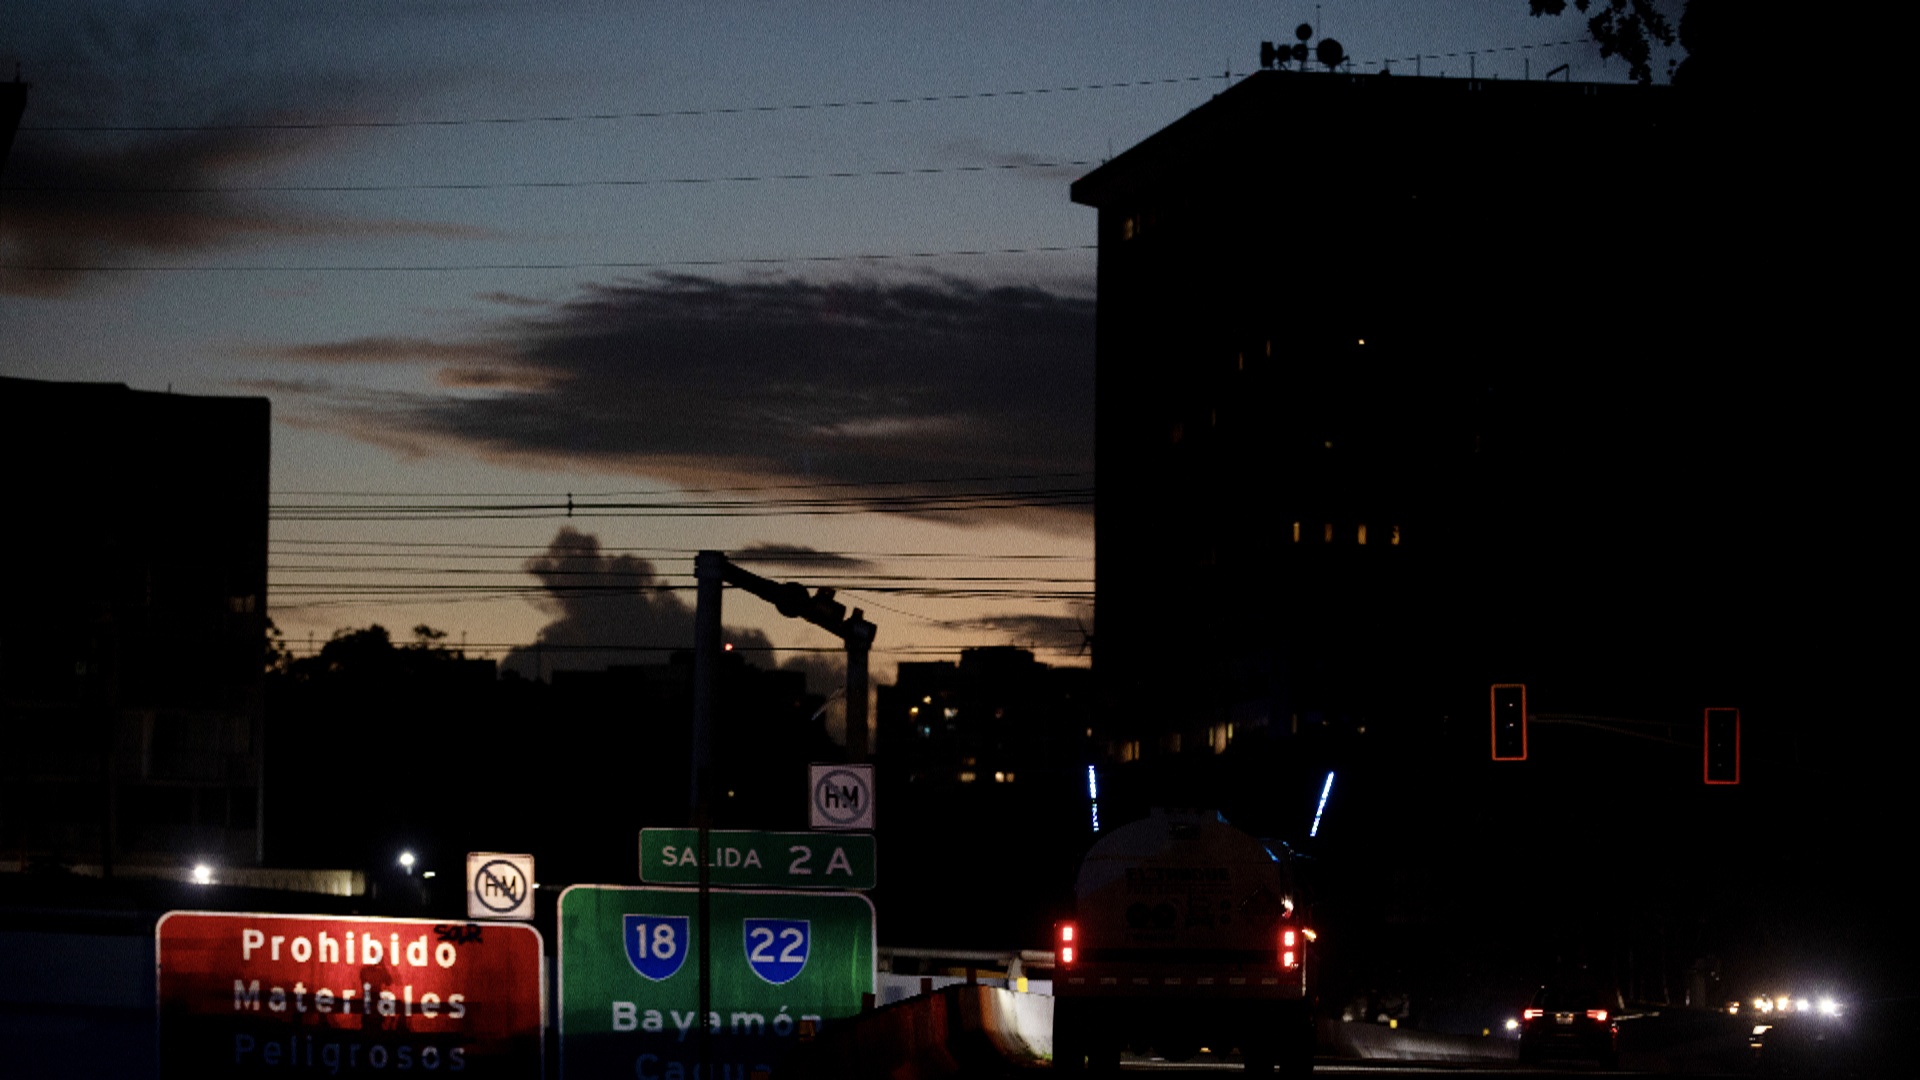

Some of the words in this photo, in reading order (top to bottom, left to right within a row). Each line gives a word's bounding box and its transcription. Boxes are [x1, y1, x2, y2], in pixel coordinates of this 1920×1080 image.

[788, 845, 813, 876] 2
[825, 846, 854, 877] A
[484, 875, 517, 898] HM
[242, 928, 457, 968] Prohibido
[635, 923, 678, 960] 18
[749, 927, 805, 963] 22
[232, 978, 467, 1019] Materiales
[232, 1032, 467, 1075] Peligrosos
